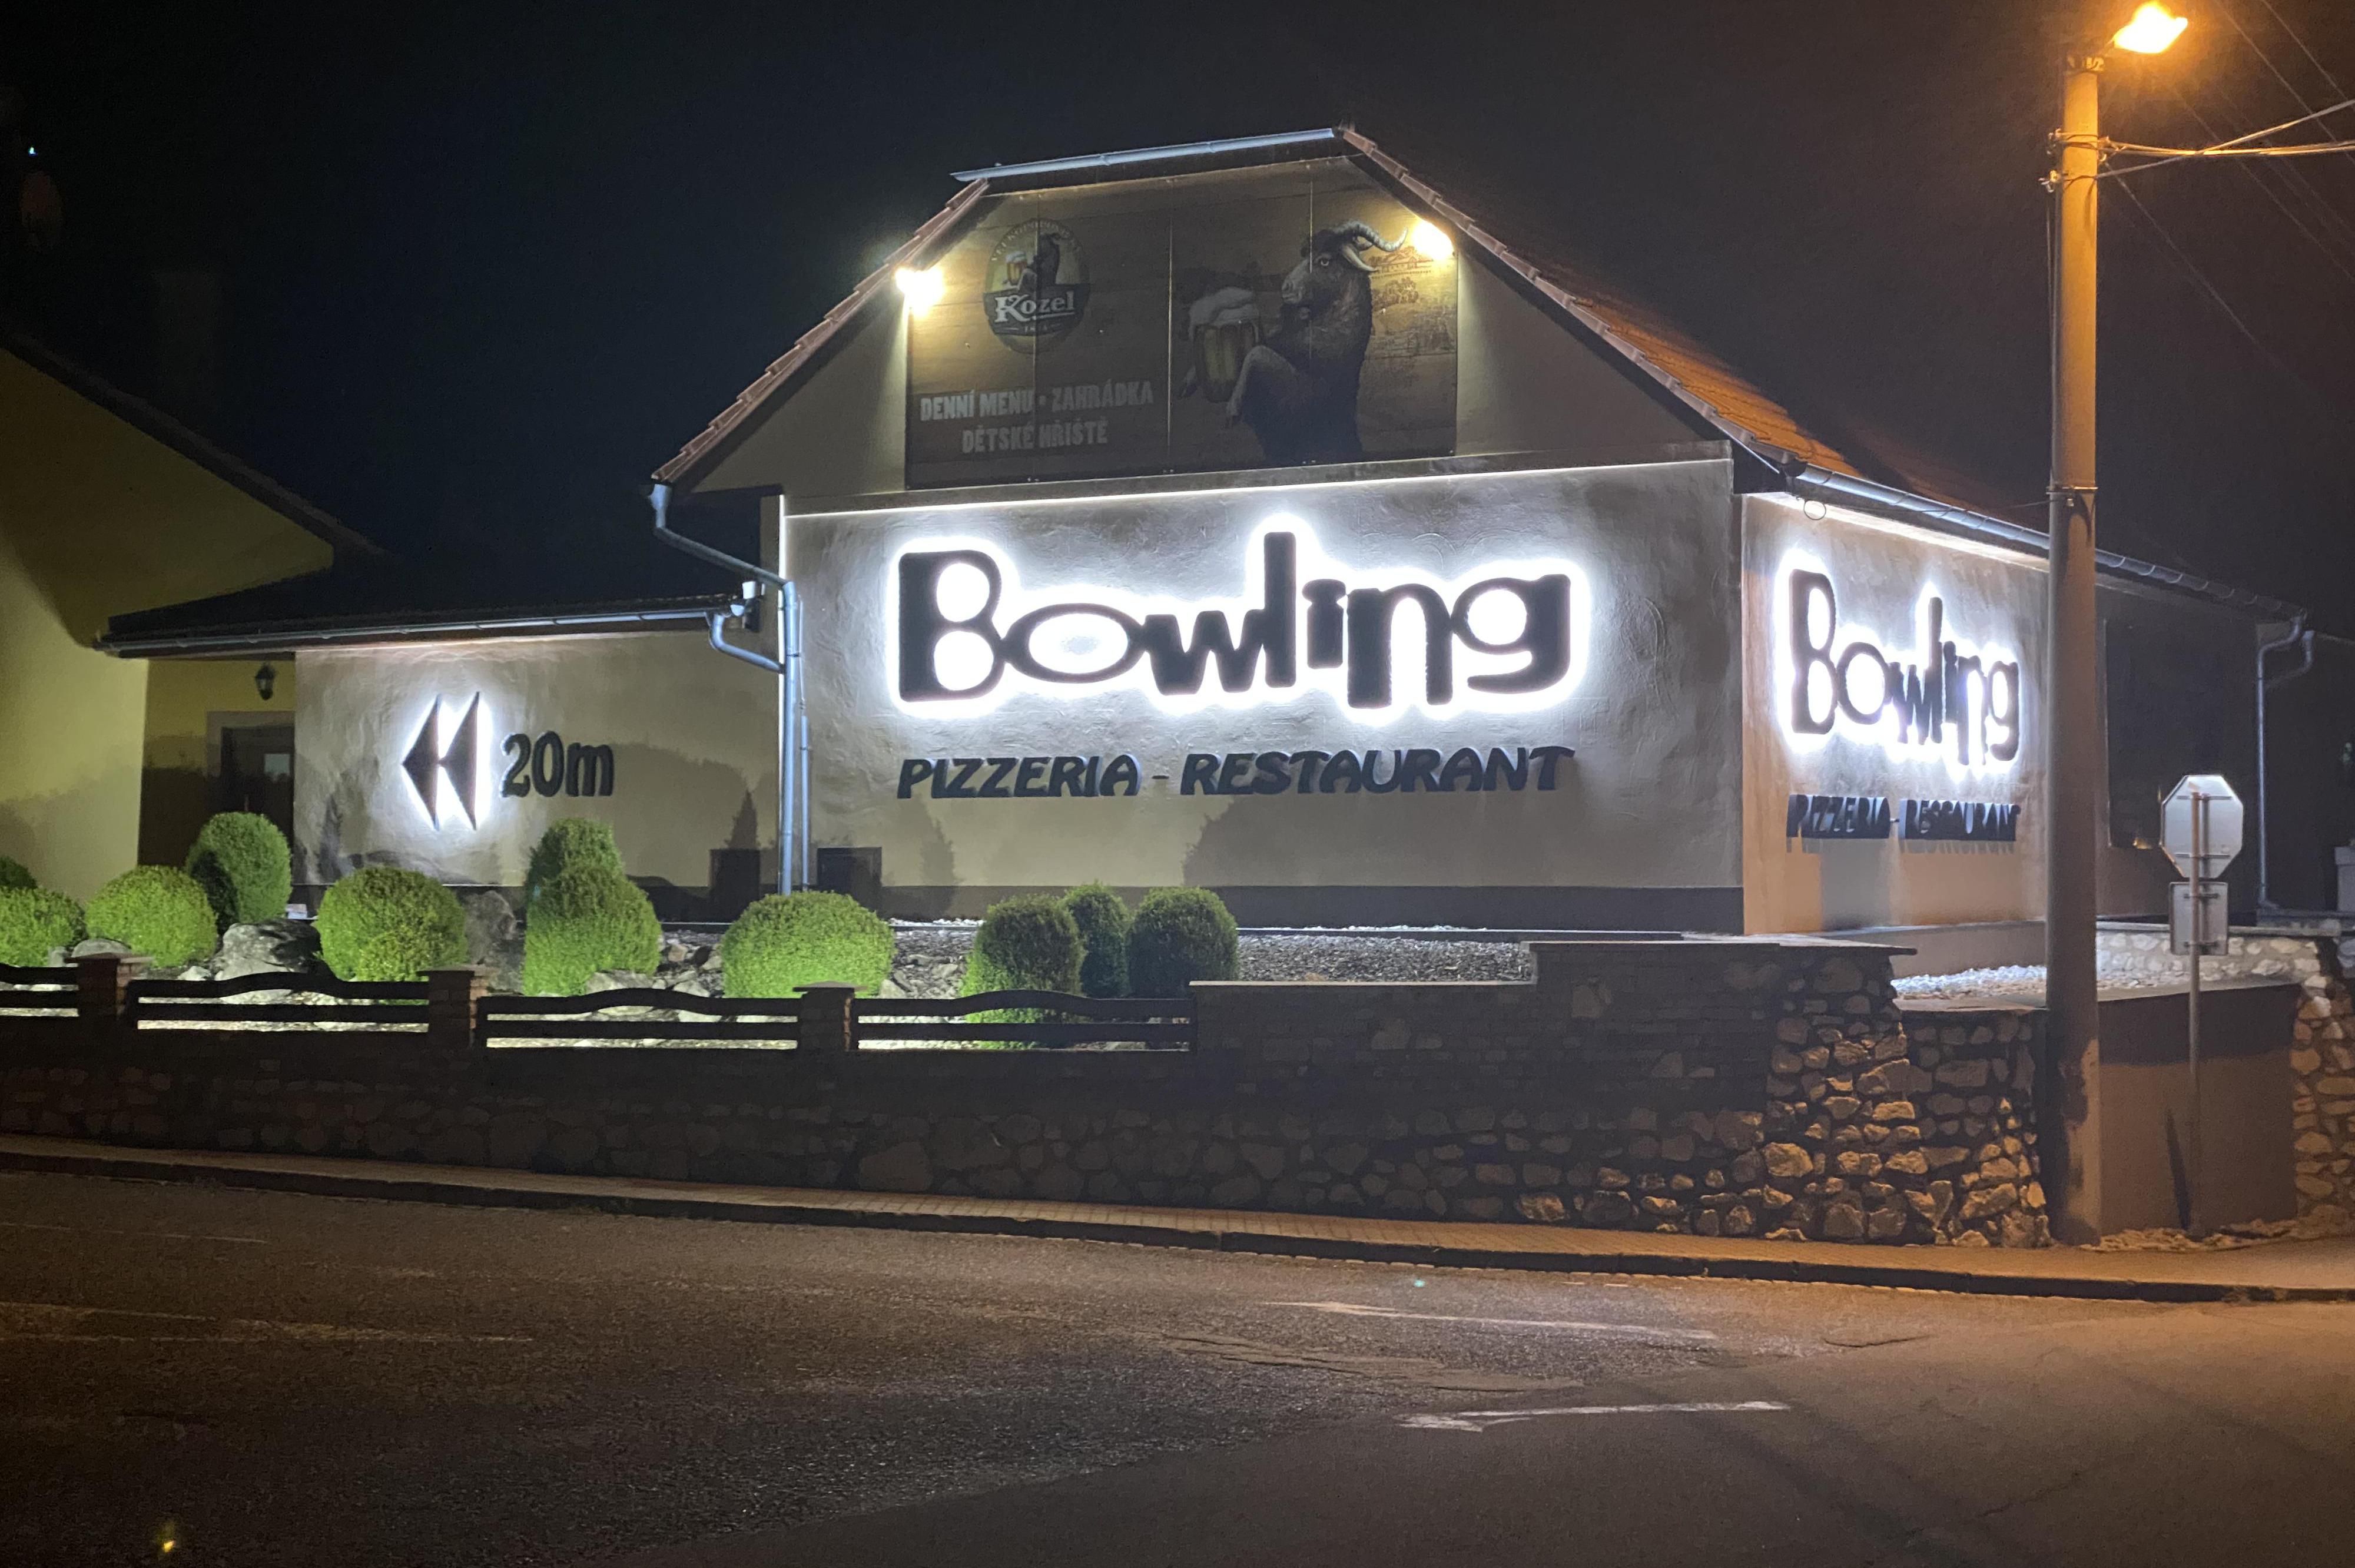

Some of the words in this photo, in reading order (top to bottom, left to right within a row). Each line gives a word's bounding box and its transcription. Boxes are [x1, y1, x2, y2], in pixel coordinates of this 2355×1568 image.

[994, 291, 1074, 323] Kozel
[920, 389, 975, 421] DENNÍ
[979, 388, 1035, 417] MENU
[1052, 379, 1154, 412] ZAHRÁDKA
[962, 422, 1035, 453] DĚTSKÉ
[1039, 416, 1108, 447] HŘIŠTĚ
[899, 532, 1571, 708] Bowling
[1789, 569, 2019, 765] Bowling
[500, 730, 614, 797] 20m
[897, 754, 1142, 799] PIZZERIA
[1180, 745, 1575, 795] RESTAURANT
